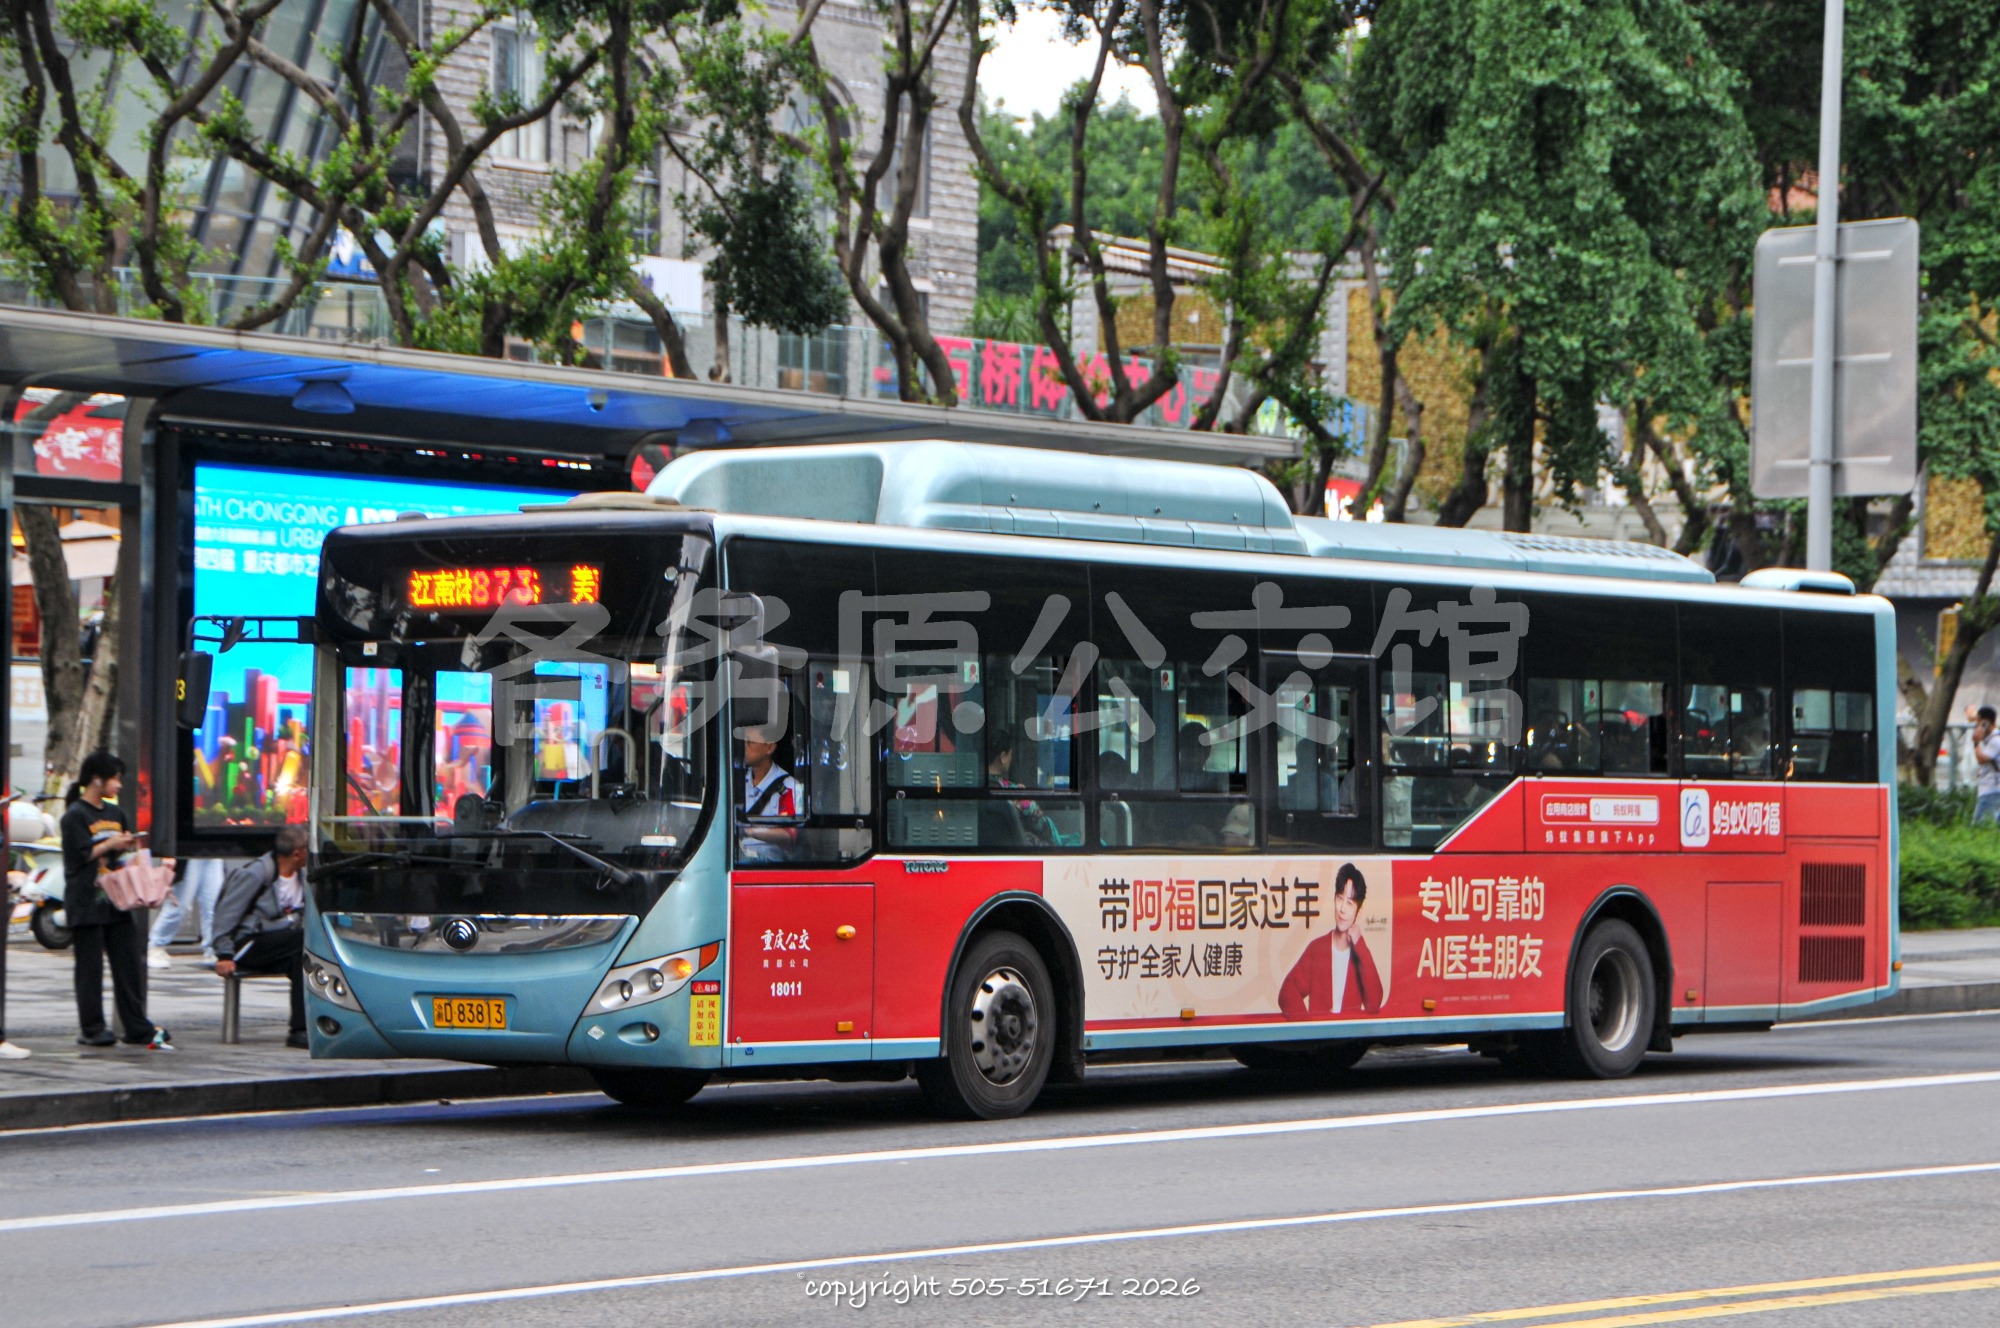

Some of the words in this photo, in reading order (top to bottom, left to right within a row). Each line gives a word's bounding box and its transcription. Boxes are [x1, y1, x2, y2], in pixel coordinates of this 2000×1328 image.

[225, 498, 338, 526] CHONGQING
[280, 528, 328, 549] URBA
[473, 567, 534, 605] 873
[572, 564, 599, 604] 美
[1613, 805, 1641, 816] 蚂蚁阿福
[1712, 801, 1781, 836] 蚂蚁阿福
[903, 861, 949, 873] YUTONG
[1098, 876, 1320, 932] 带阿福回家过年
[1418, 875, 1545, 923] 专业可靠的
[760, 929, 811, 951] 重庆公交
[1097, 942, 1243, 980] 守护全家人健康
[1416, 932, 1544, 980] AI医生朋友
[770, 981, 802, 997] 18011
